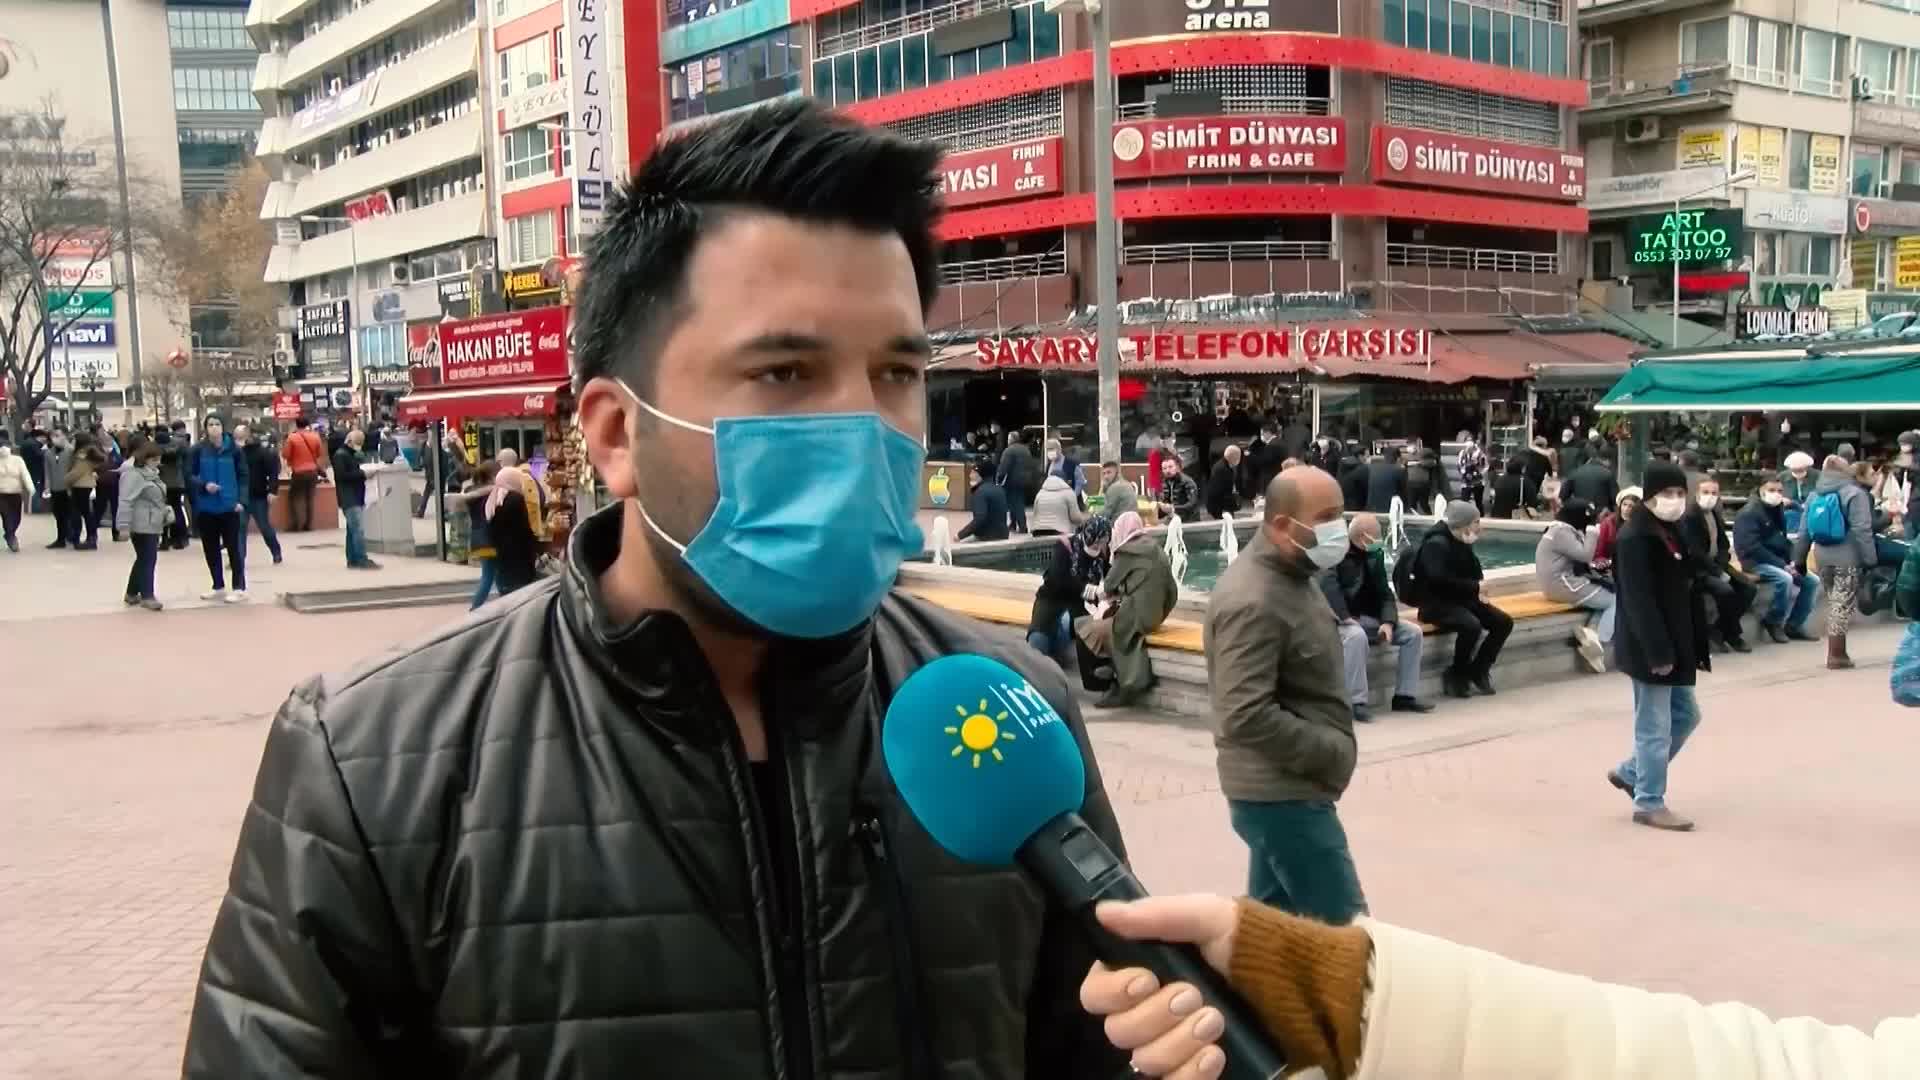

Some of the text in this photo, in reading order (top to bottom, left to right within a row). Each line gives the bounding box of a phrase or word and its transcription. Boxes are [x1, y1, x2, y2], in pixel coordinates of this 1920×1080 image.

[1184, 10, 1270, 31] arena
[1151, 121, 1338, 150] SİMİT DÜNYASI
[1012, 143, 1046, 161] FIRIN
[1187, 152, 1315, 168] FIRIN & CAFE
[1023, 161, 1034, 174] &
[1414, 141, 1555, 185] SİMİT DÜNYASI
[1014, 175, 1046, 191] CAFE
[1560, 183, 1584, 197] CAFE
[1661, 211, 1706, 231] ART
[1640, 228, 1728, 250] TATTOO
[1634, 250, 1666, 262] 0553
[1746, 310, 1791, 334] LOKMAN
[1794, 306, 1829, 334] HEKİM
[446, 328, 534, 364] HAKAN BÜFE
[976, 336, 1124, 366] SAKARY
[1129, 332, 1289, 362] TELEFON
